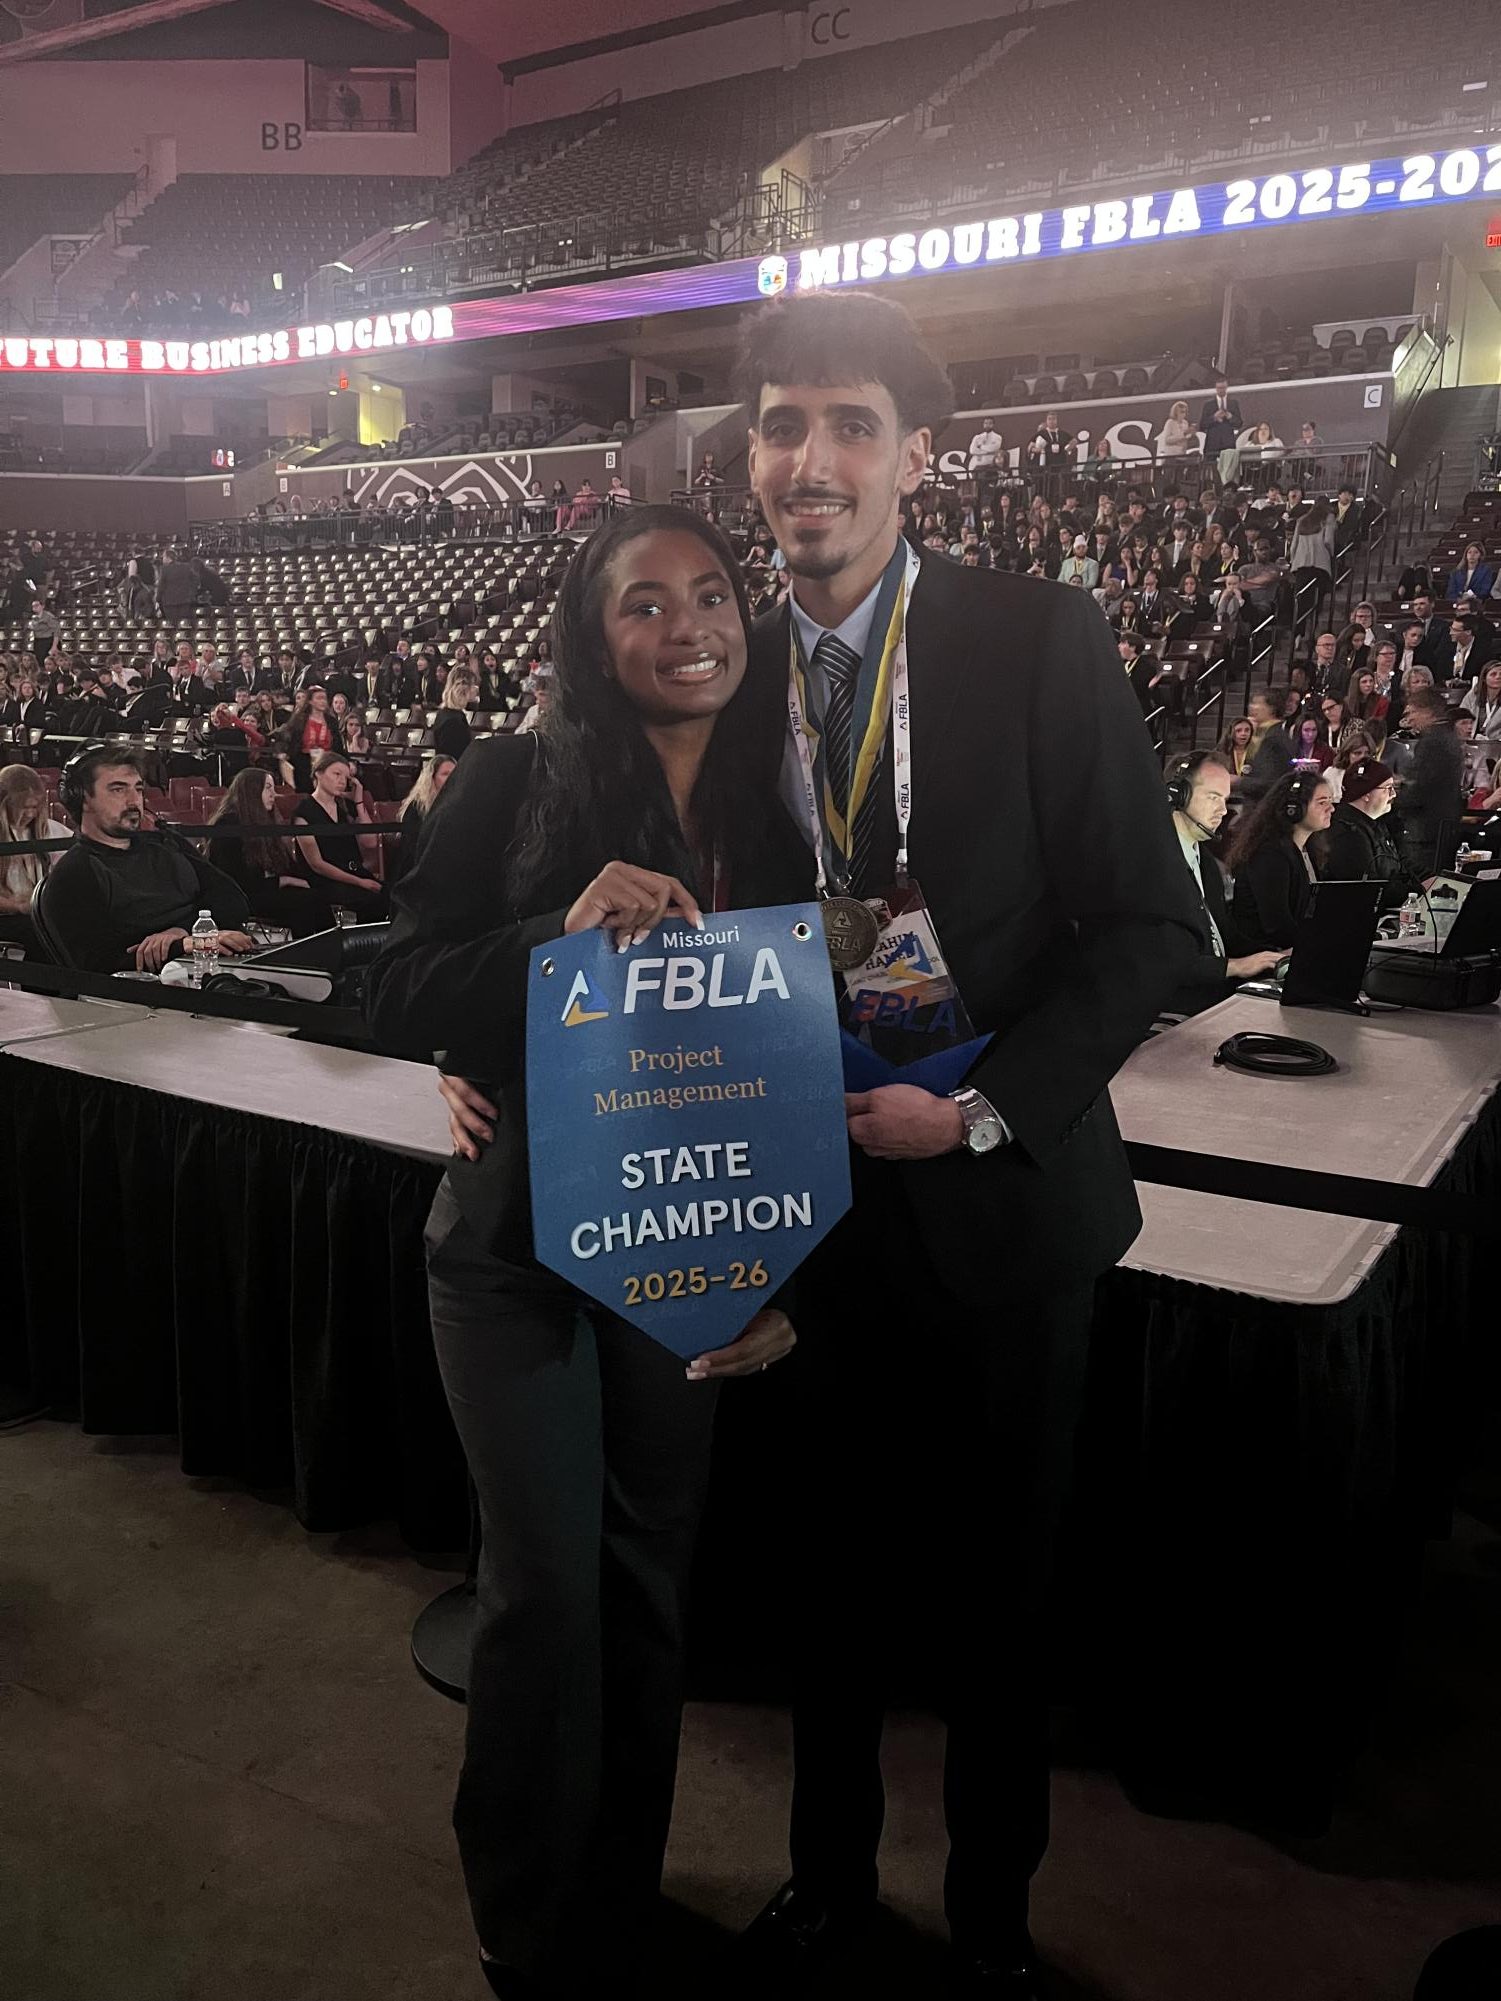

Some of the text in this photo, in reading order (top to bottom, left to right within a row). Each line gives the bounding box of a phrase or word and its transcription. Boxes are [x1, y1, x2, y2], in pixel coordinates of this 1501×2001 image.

[811, 8, 850, 45] CC
[262, 122, 302, 150] BB
[799, 213, 1042, 289] MISSOURI
[1061, 189, 1201, 249] FBLA
[0, 306, 454, 370] UTURE BUSINESS EDUCATOR
[899, 694, 909, 720] FBLA
[900, 783, 910, 809] FBLA
[662, 925, 740, 950] Missouri
[623, 947, 791, 1014] FBLA
[629, 1044, 724, 1075] Project
[593, 1076, 768, 1116] Management
[621, 1141, 752, 1190] STATE
[570, 1191, 813, 1260] CHAMPION
[623, 1259, 769, 1306] 2025-26
